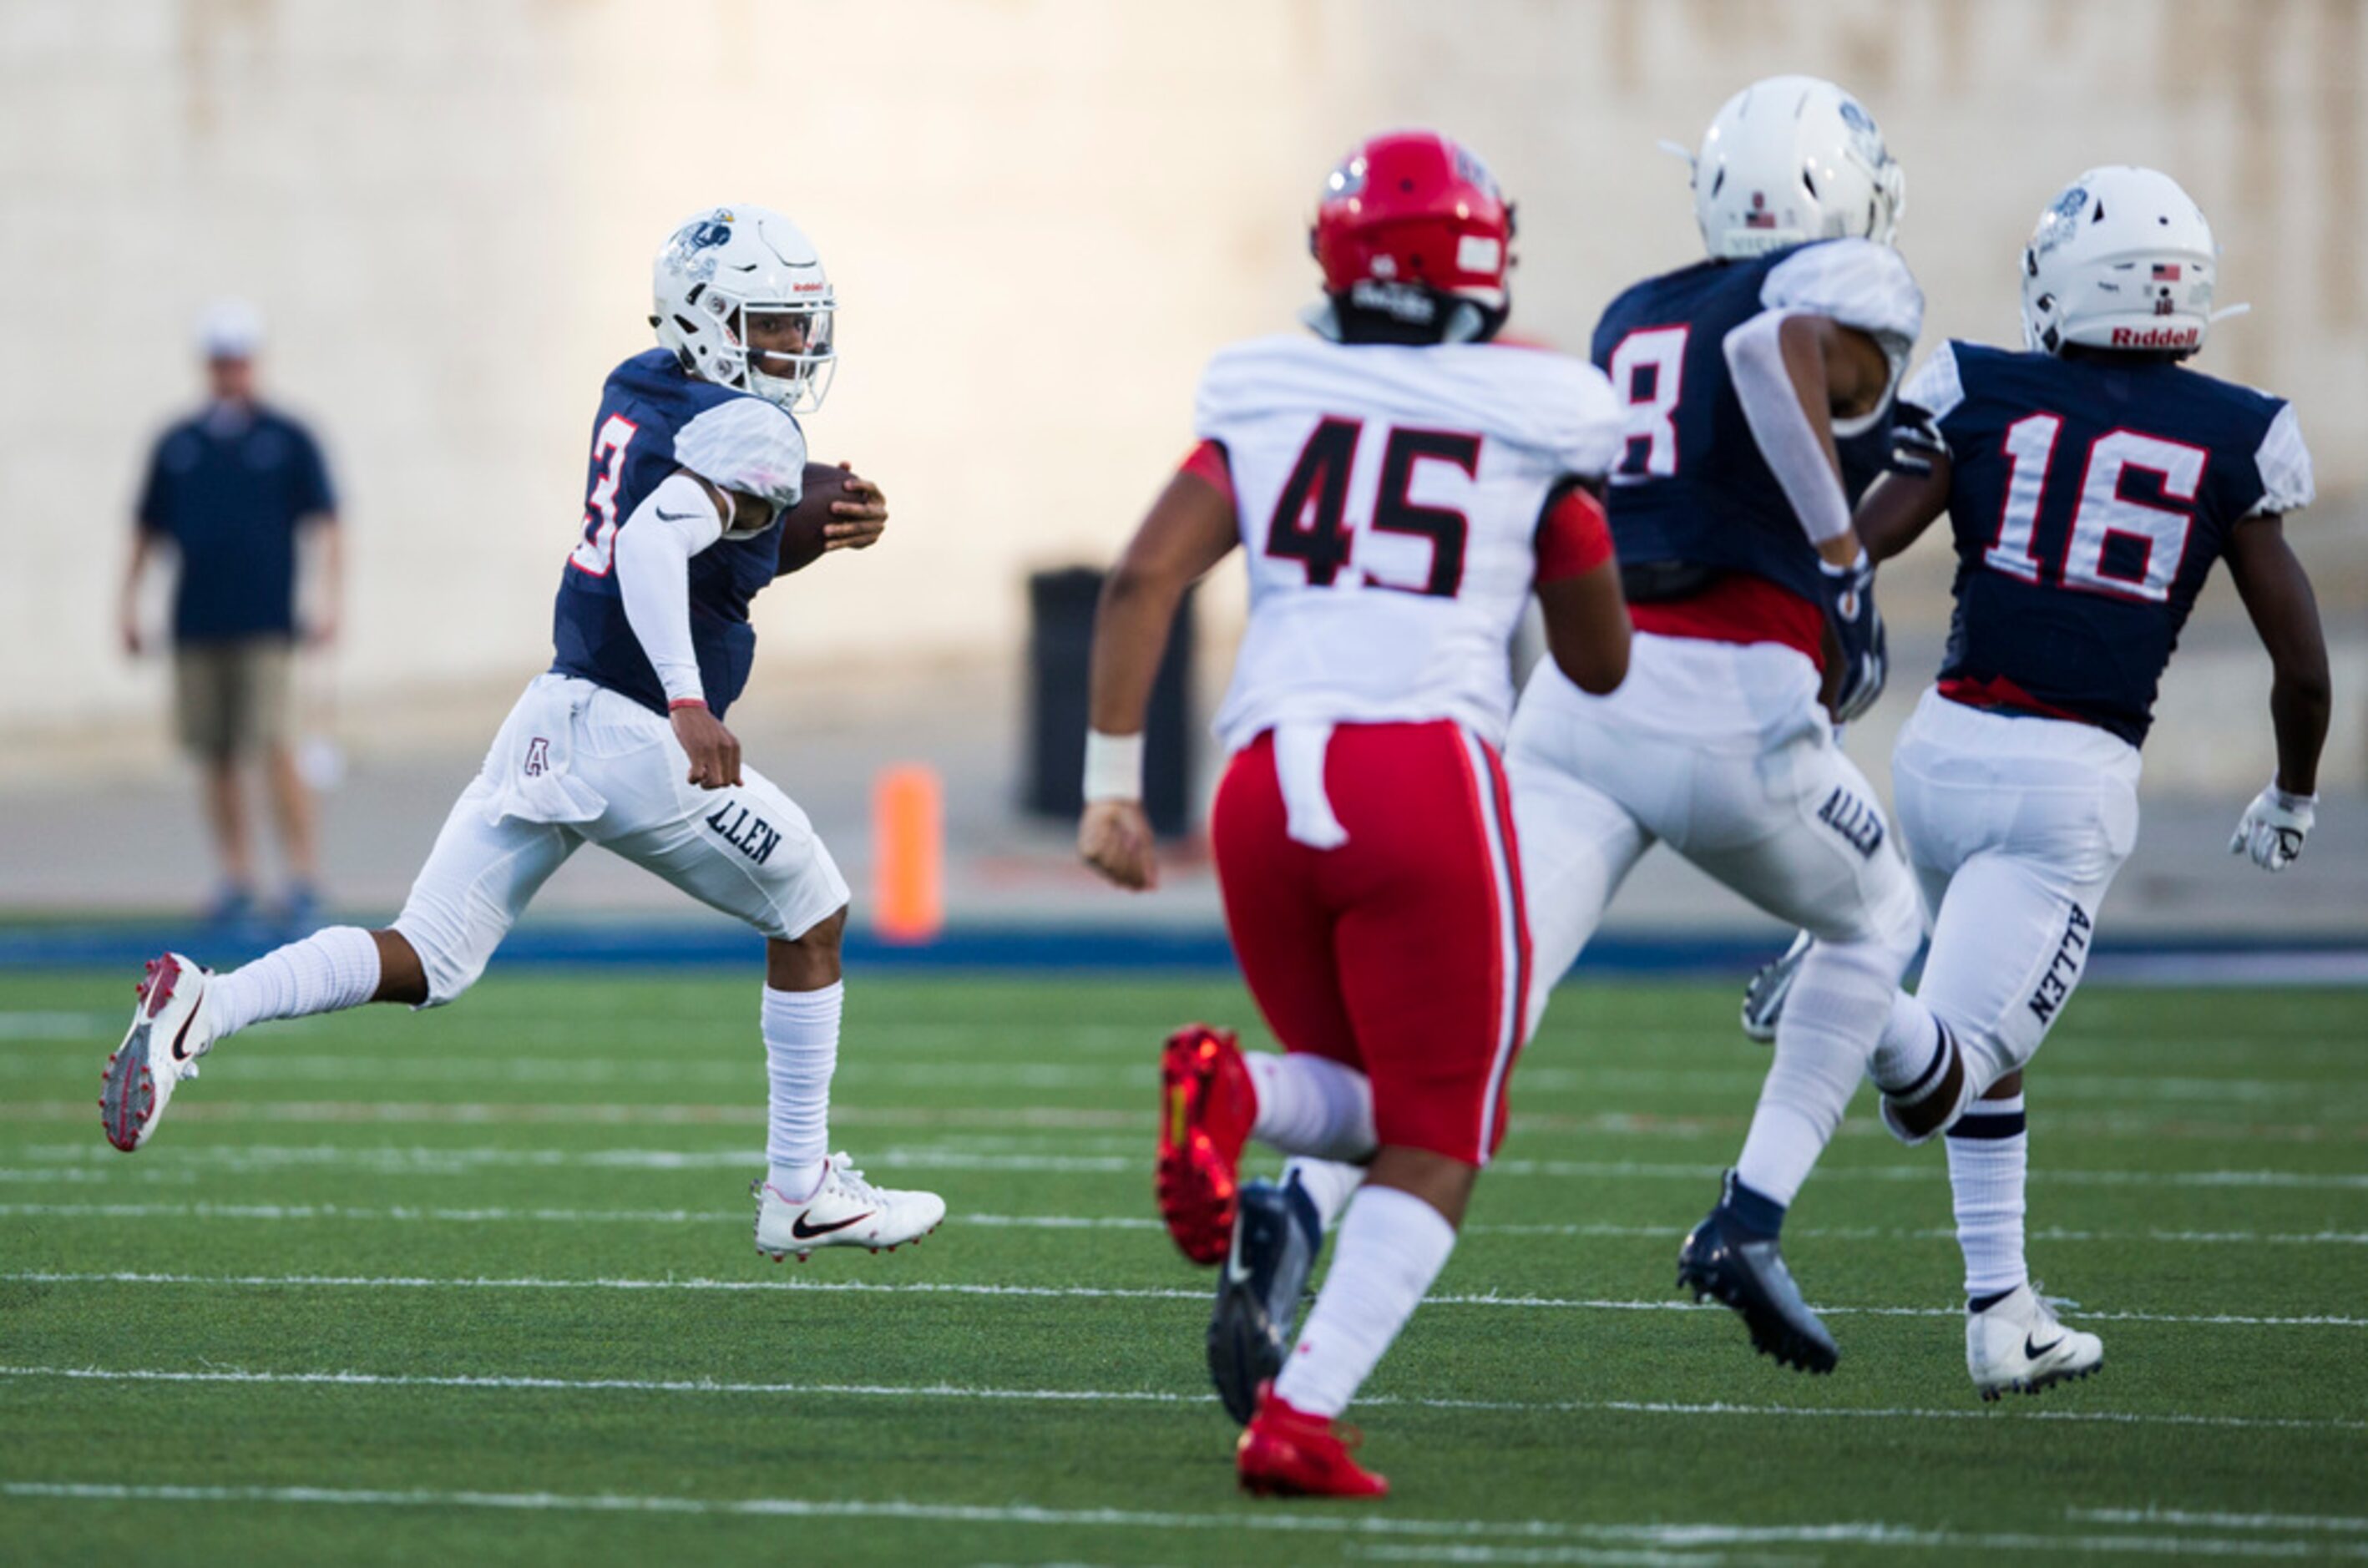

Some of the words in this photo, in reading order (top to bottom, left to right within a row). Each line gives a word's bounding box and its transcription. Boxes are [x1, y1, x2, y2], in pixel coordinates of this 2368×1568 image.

[1608, 322, 1692, 477] 8
[2111, 327, 2198, 346] Riddell
[569, 412, 638, 578] 3
[1263, 412, 1483, 600] 45
[1982, 410, 2211, 604] 16
[2027, 902, 2092, 1026] ALLEN
